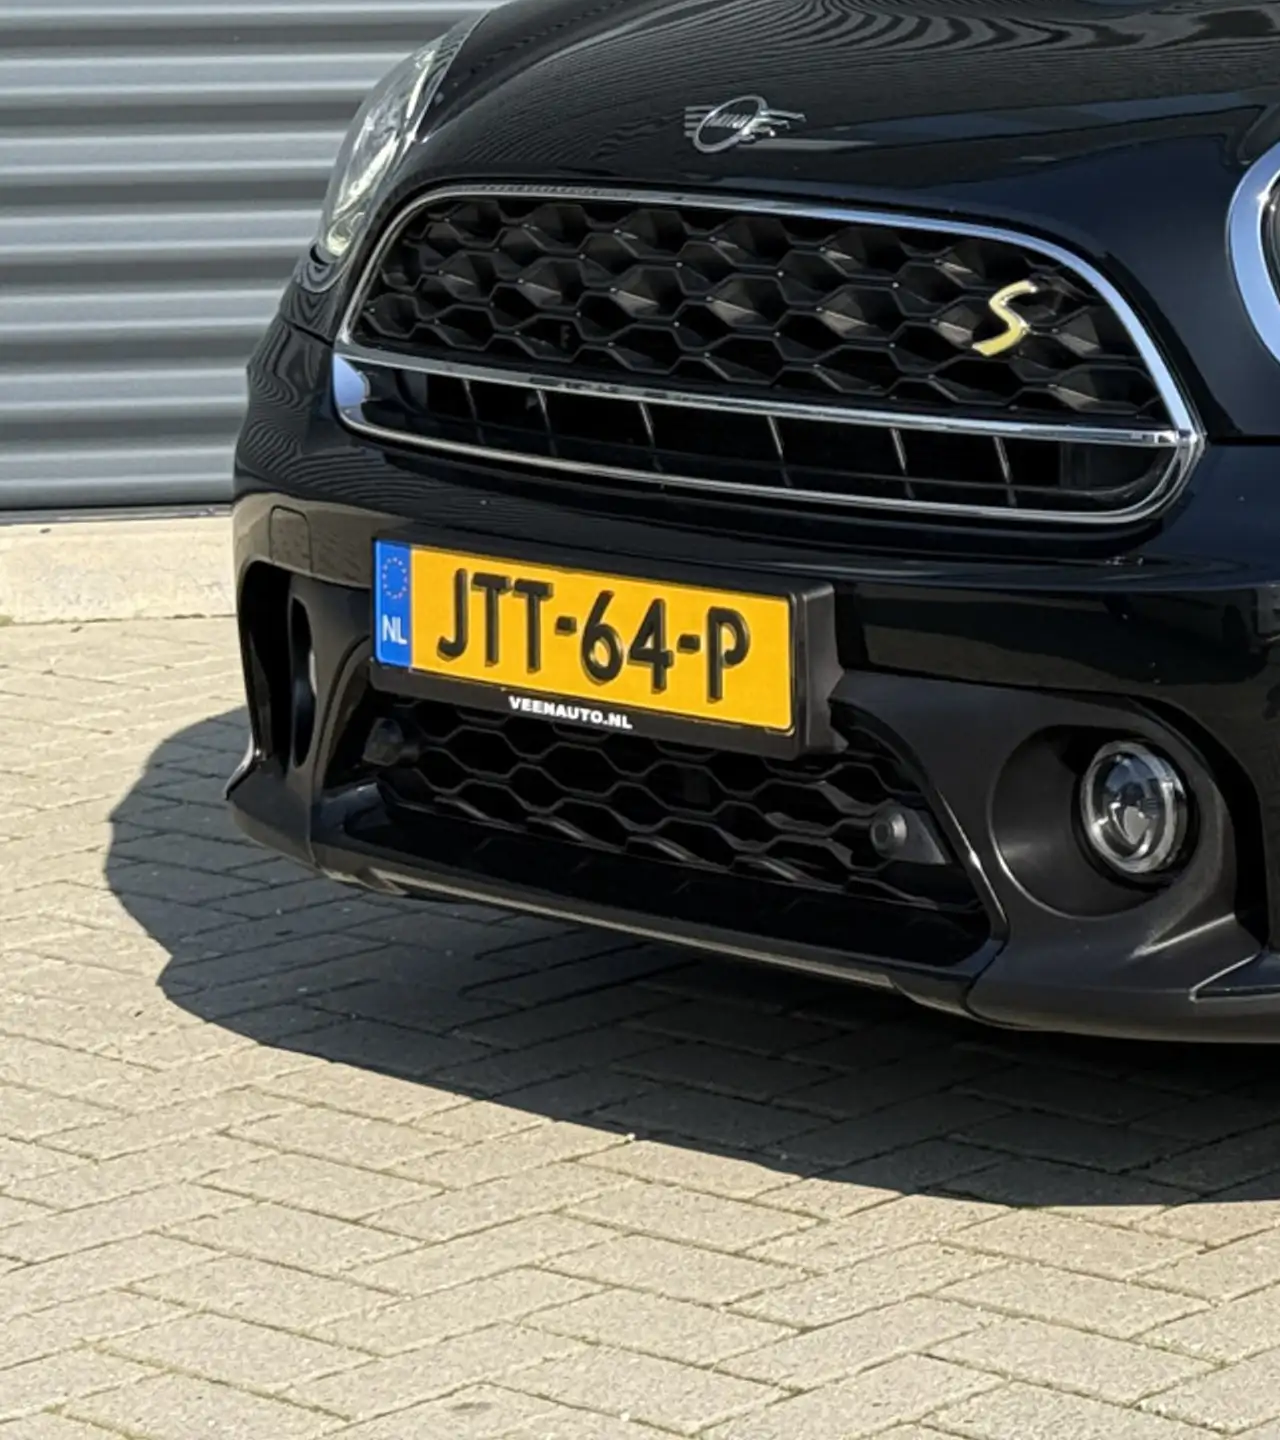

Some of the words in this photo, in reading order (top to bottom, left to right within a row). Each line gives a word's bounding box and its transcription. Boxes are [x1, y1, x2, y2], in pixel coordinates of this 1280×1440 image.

[971, 279, 1039, 357] S
[382, 613, 408, 645] NL
[437, 567, 751, 703] JTT-64-P
[508, 695, 634, 730] VEENAUTO.NL
